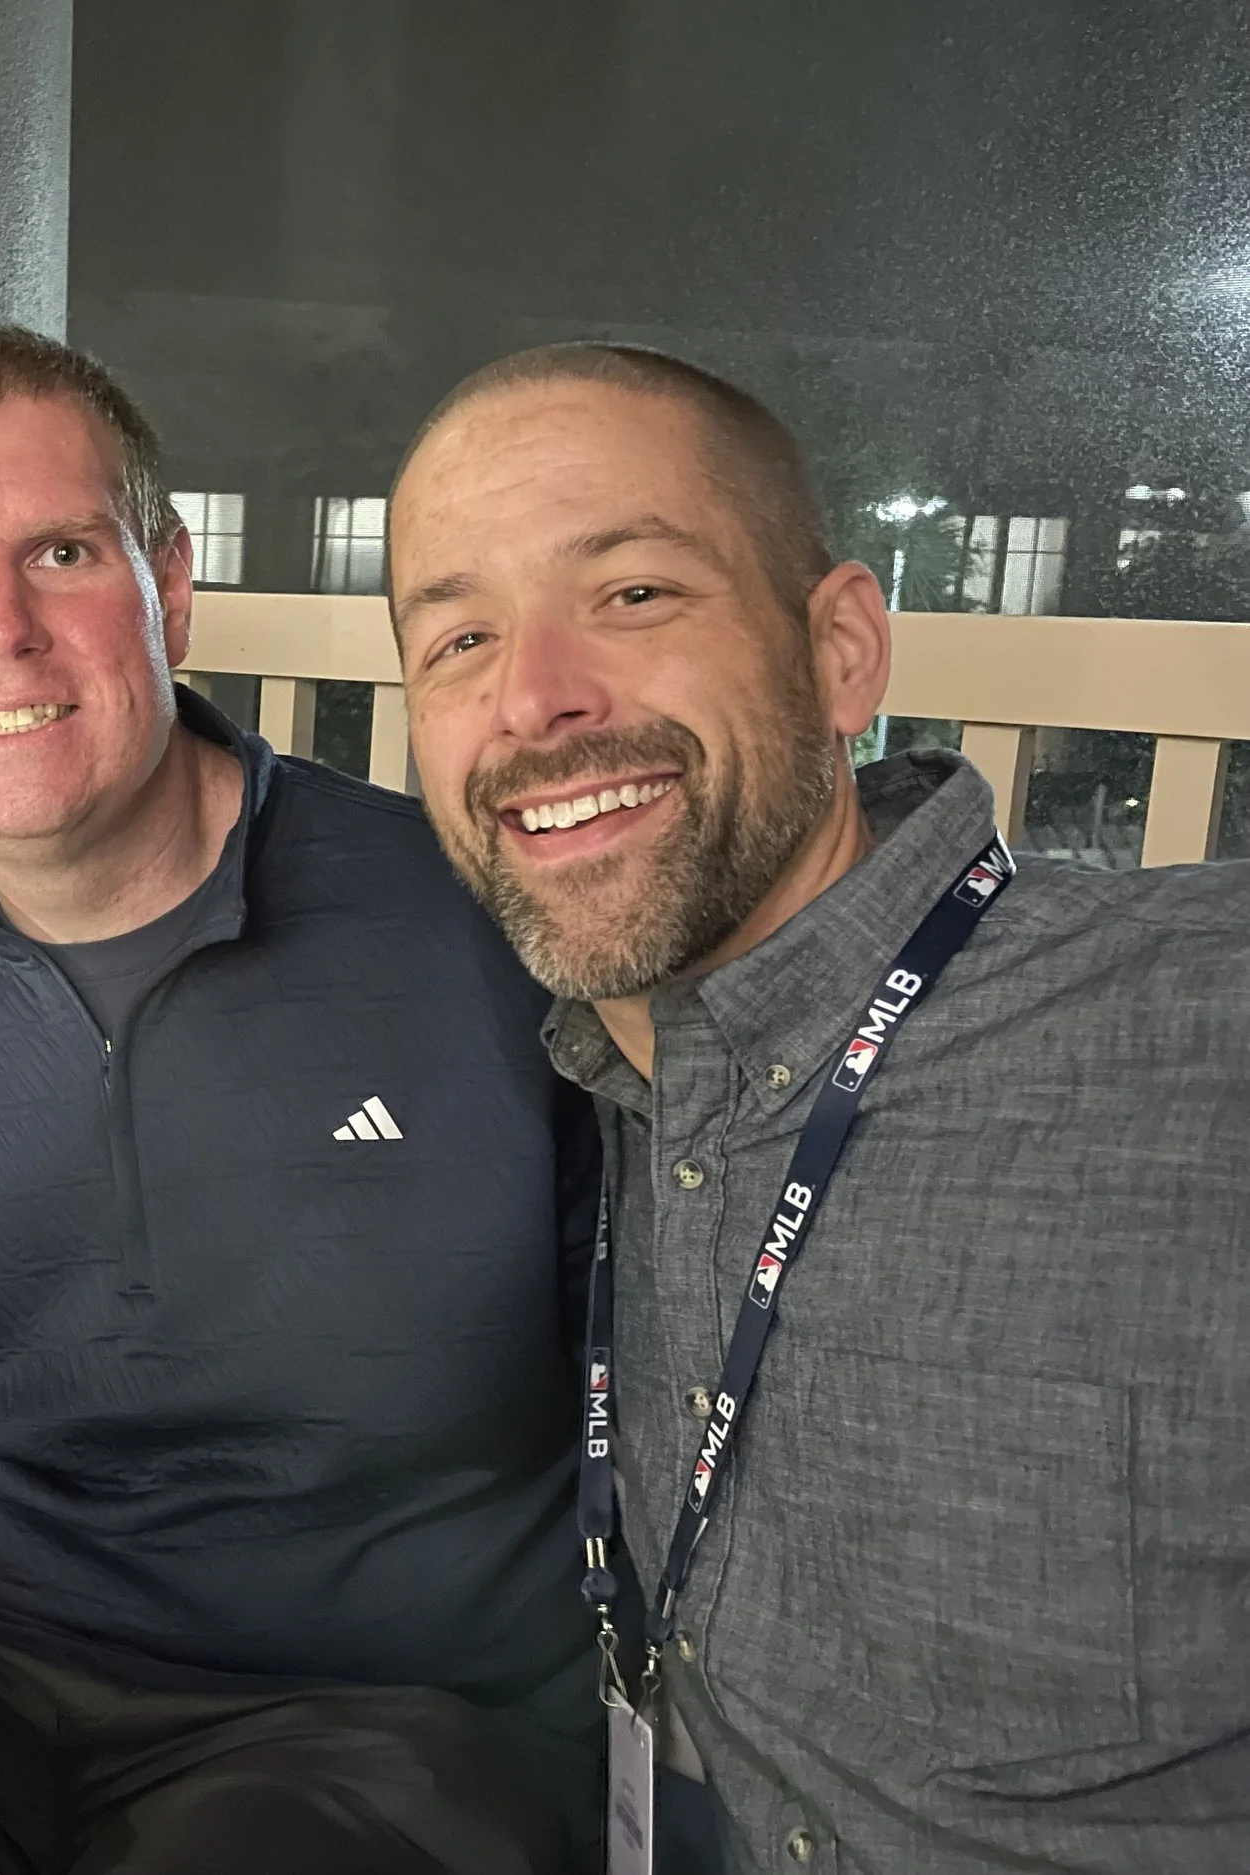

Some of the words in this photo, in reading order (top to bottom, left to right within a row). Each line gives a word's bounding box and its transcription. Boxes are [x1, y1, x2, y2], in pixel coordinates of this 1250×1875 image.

[857, 968, 923, 1043] MLB
[765, 1182, 813, 1261] MLB
[587, 1393, 608, 1459] MLB
[700, 1391, 736, 1468] MLB
